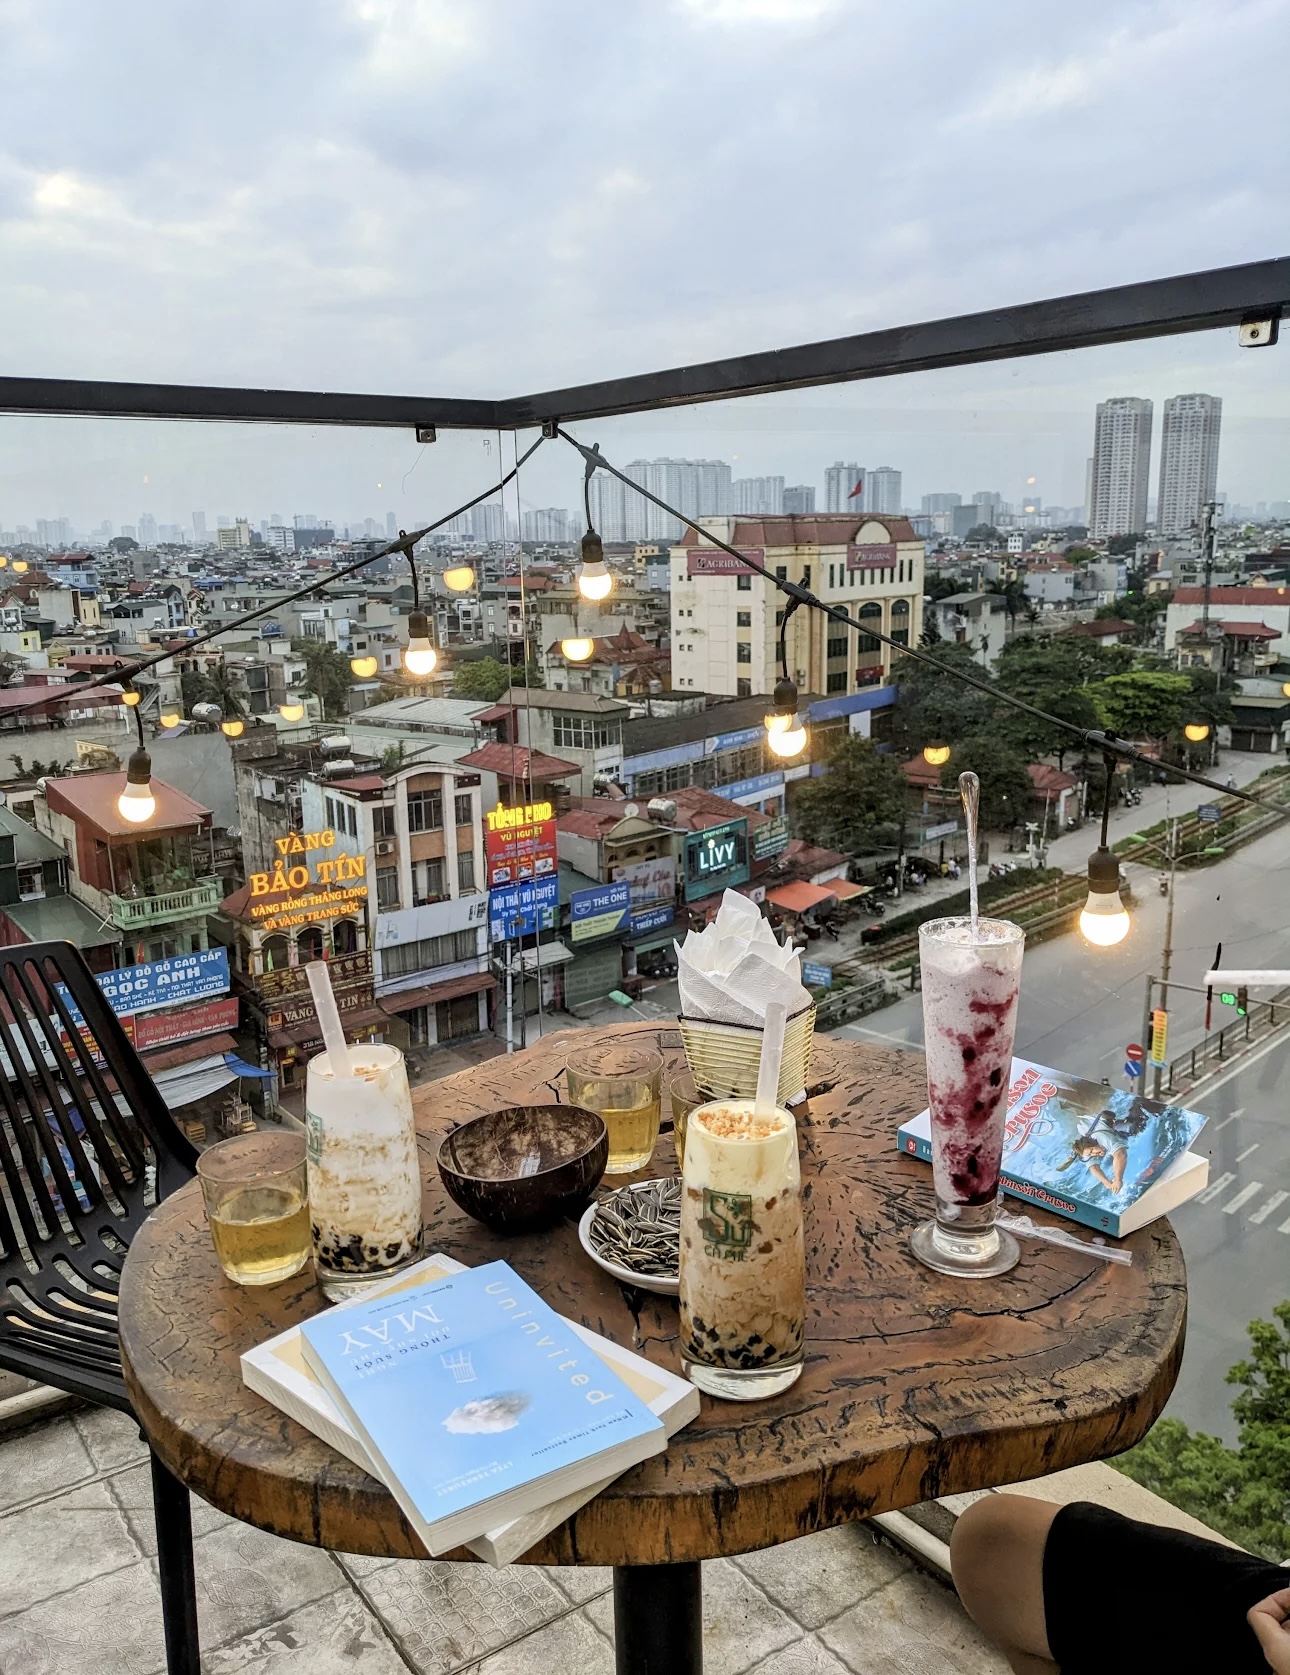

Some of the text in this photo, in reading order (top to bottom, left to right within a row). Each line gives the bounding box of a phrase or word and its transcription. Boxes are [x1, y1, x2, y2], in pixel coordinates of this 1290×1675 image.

[706, 559, 750, 568] AGRIBAN
[275, 829, 336, 855] VÀNG
[249, 853, 366, 897] BẢO TÍN
[251, 903, 280, 917] VÀNG
[281, 896, 308, 912] RỒNG
[342, 886, 368, 900] LONG
[593, 896, 610, 907] THE
[610, 891, 627, 903] ONE
[263, 901, 360, 931] VÀ VÀNG TRANG SỨC
[174, 957, 197, 968] CAO
[200, 950, 222, 963] CẤP
[103, 978, 149, 997] GỌC
[157, 966, 200, 986] ANH
[338, 1304, 443, 1356] MÂY
[484, 1281, 614, 1405] Uninvited
